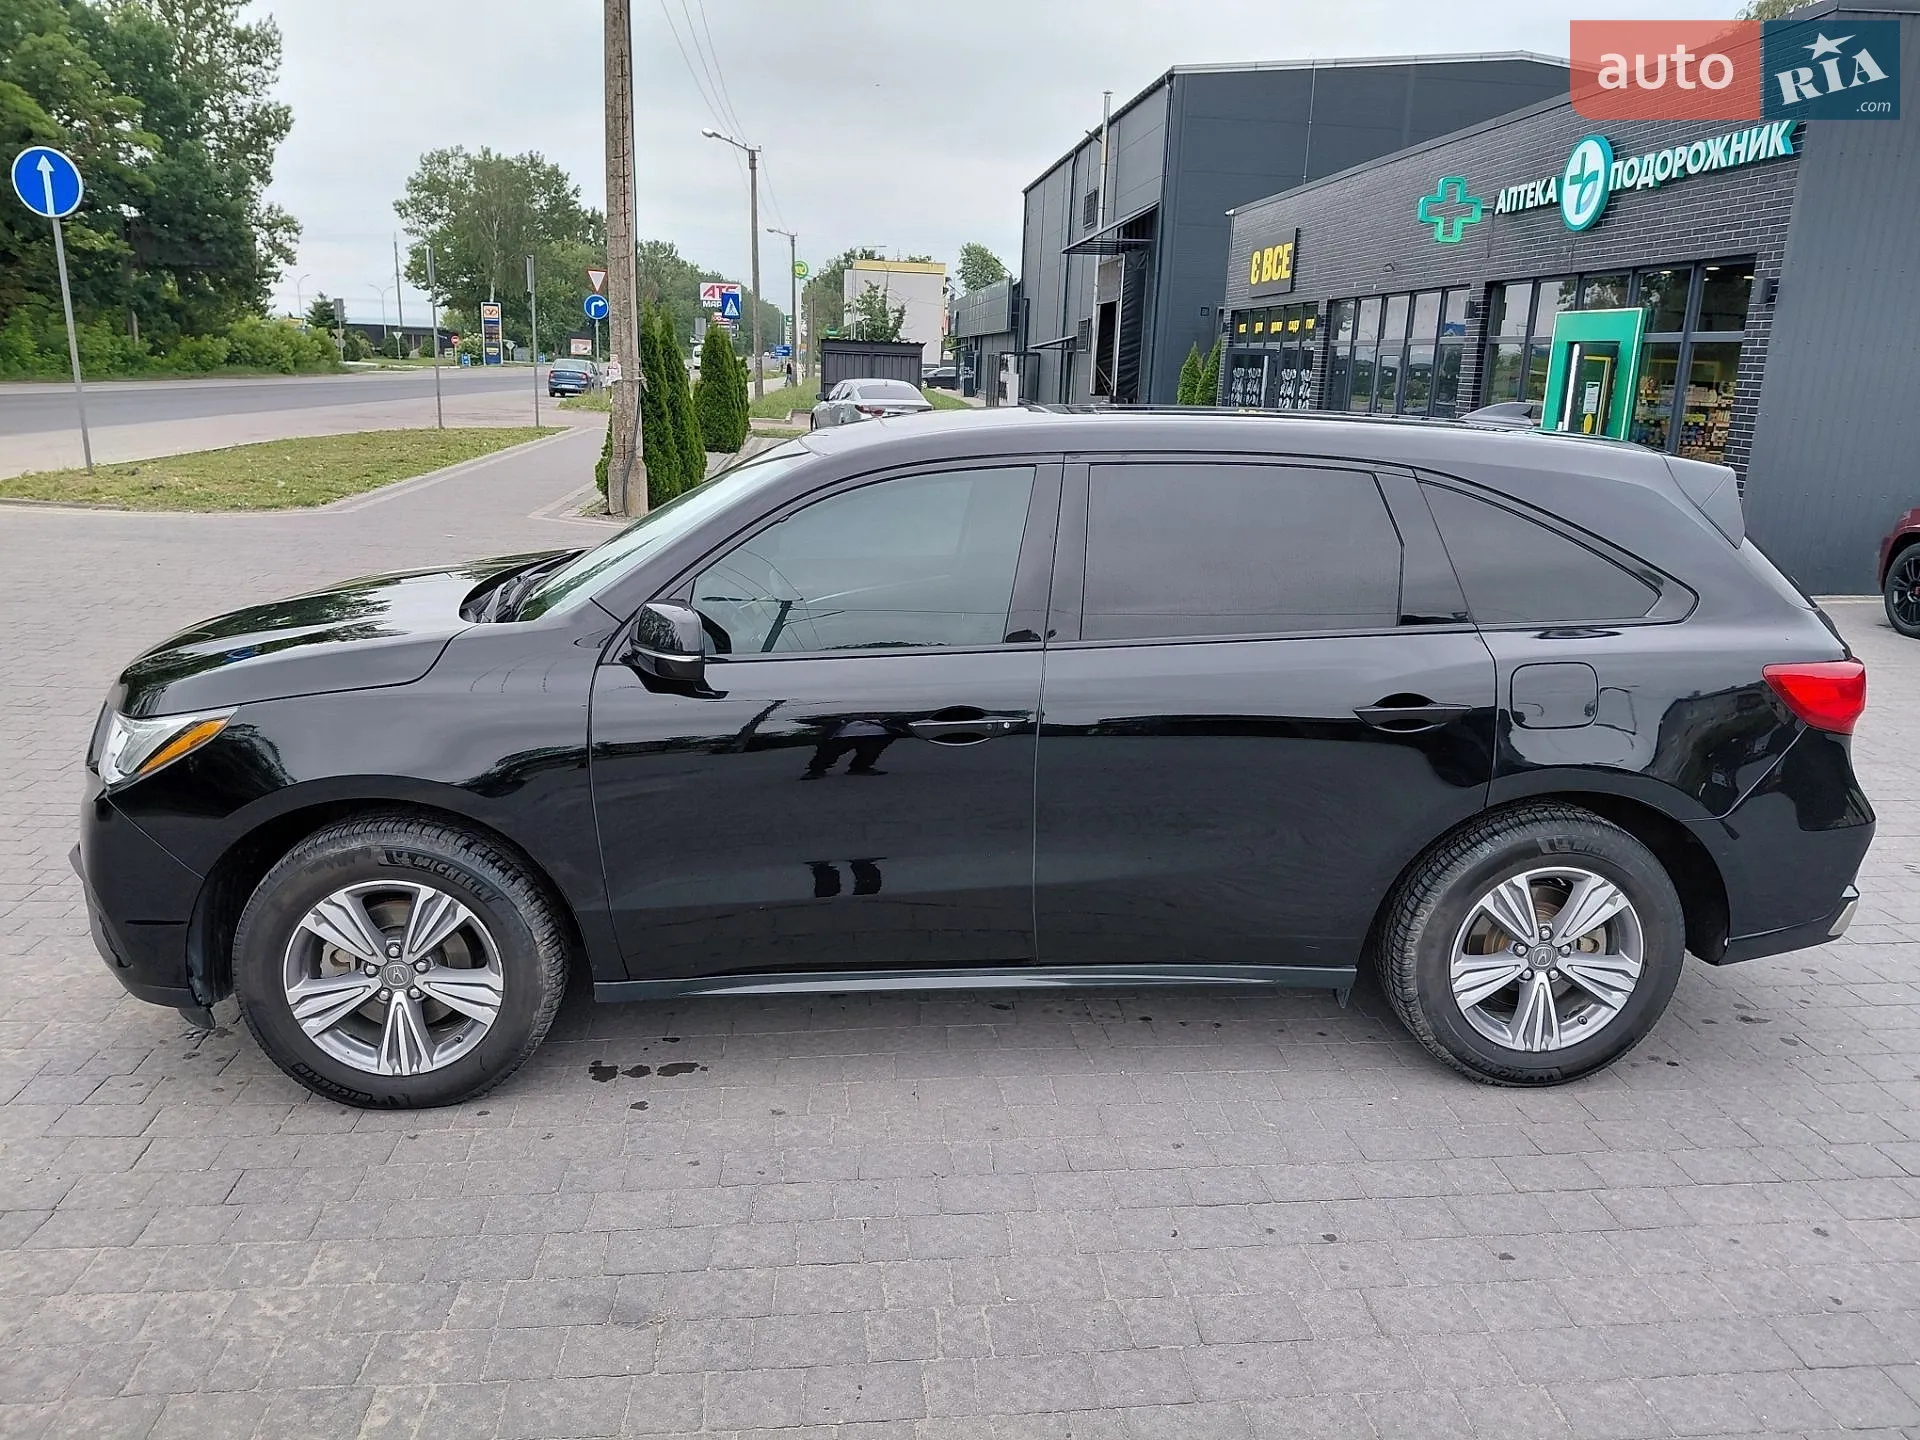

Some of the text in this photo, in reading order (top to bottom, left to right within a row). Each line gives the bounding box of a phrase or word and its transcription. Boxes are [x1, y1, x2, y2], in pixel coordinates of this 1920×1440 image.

[1494, 120, 1797, 215] АПТЕКА ПОДОРОЖНИК
[1250, 242, 1293, 285] Є ВСЕ
